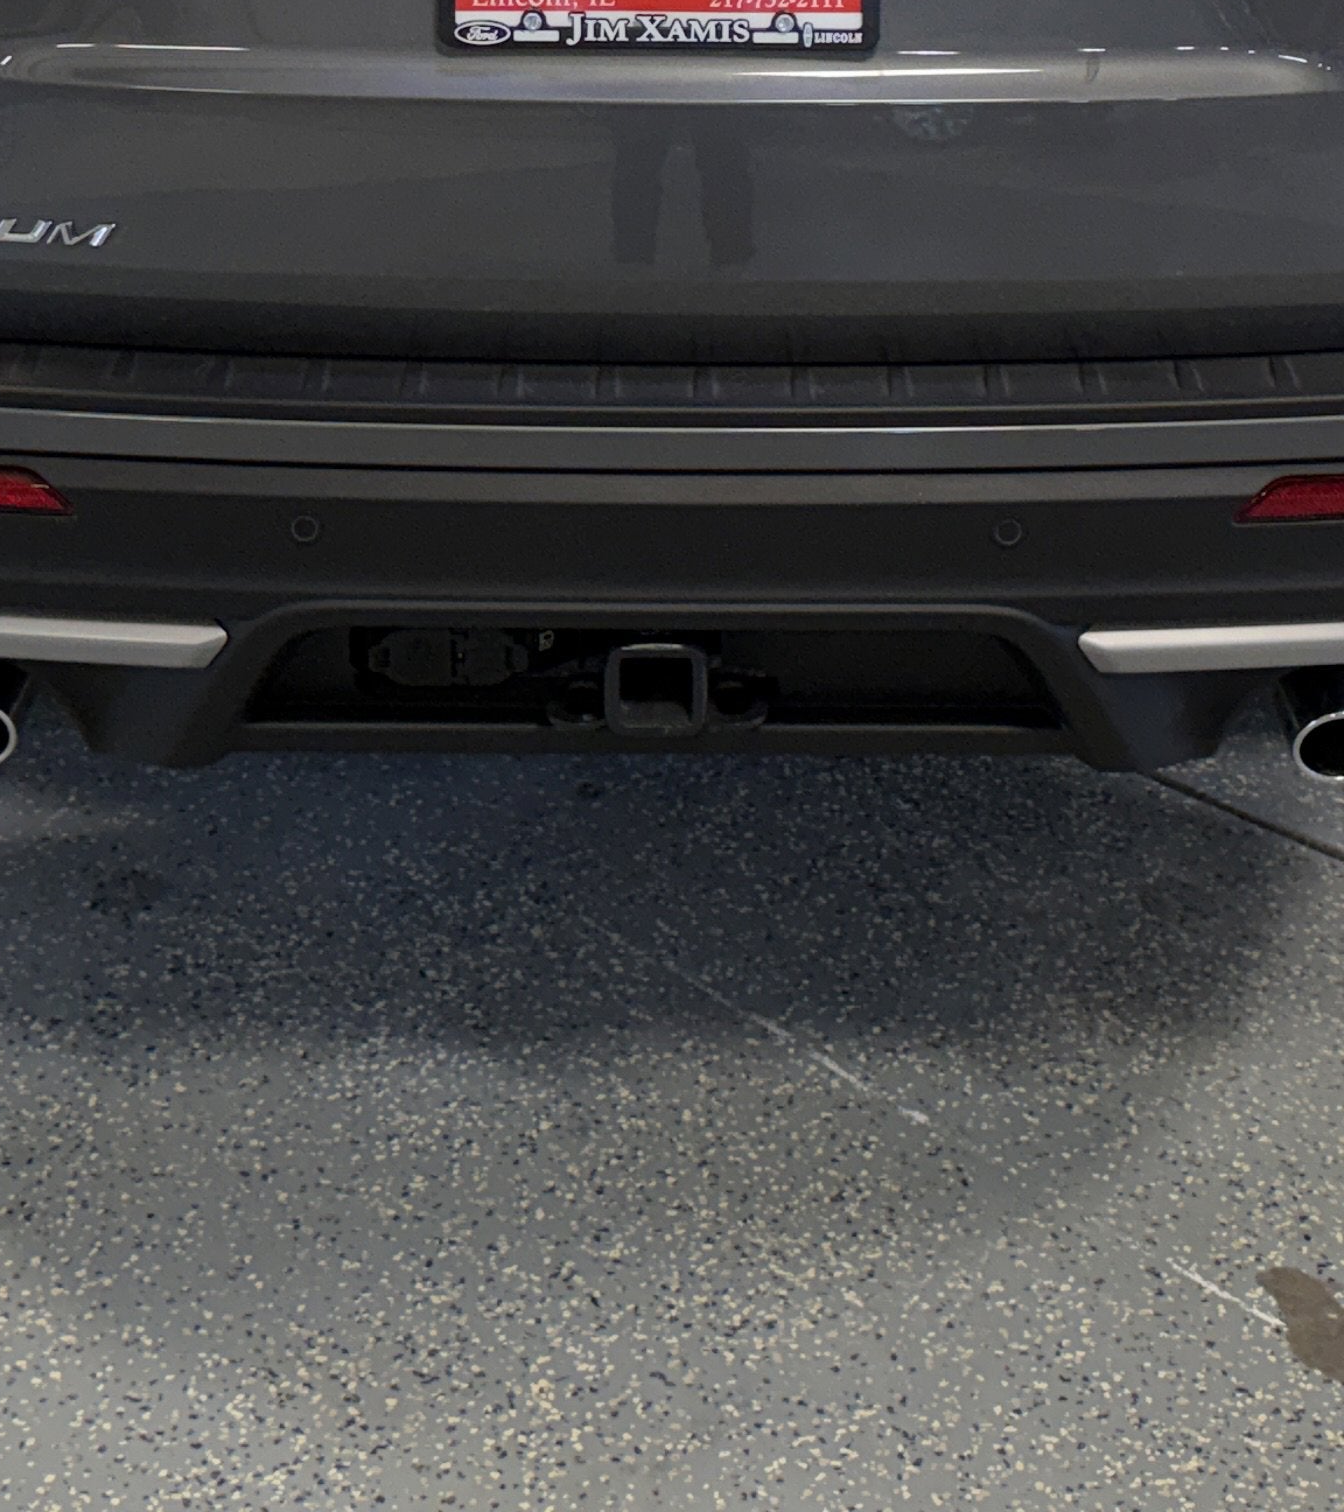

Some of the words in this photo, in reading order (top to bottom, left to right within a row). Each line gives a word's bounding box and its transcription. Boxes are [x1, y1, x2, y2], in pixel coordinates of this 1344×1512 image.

[467, 26, 498, 41] Ford
[566, 13, 629, 45] JIM
[636, 14, 751, 45] XAMIS
[814, 32, 863, 44] LINCOLN
